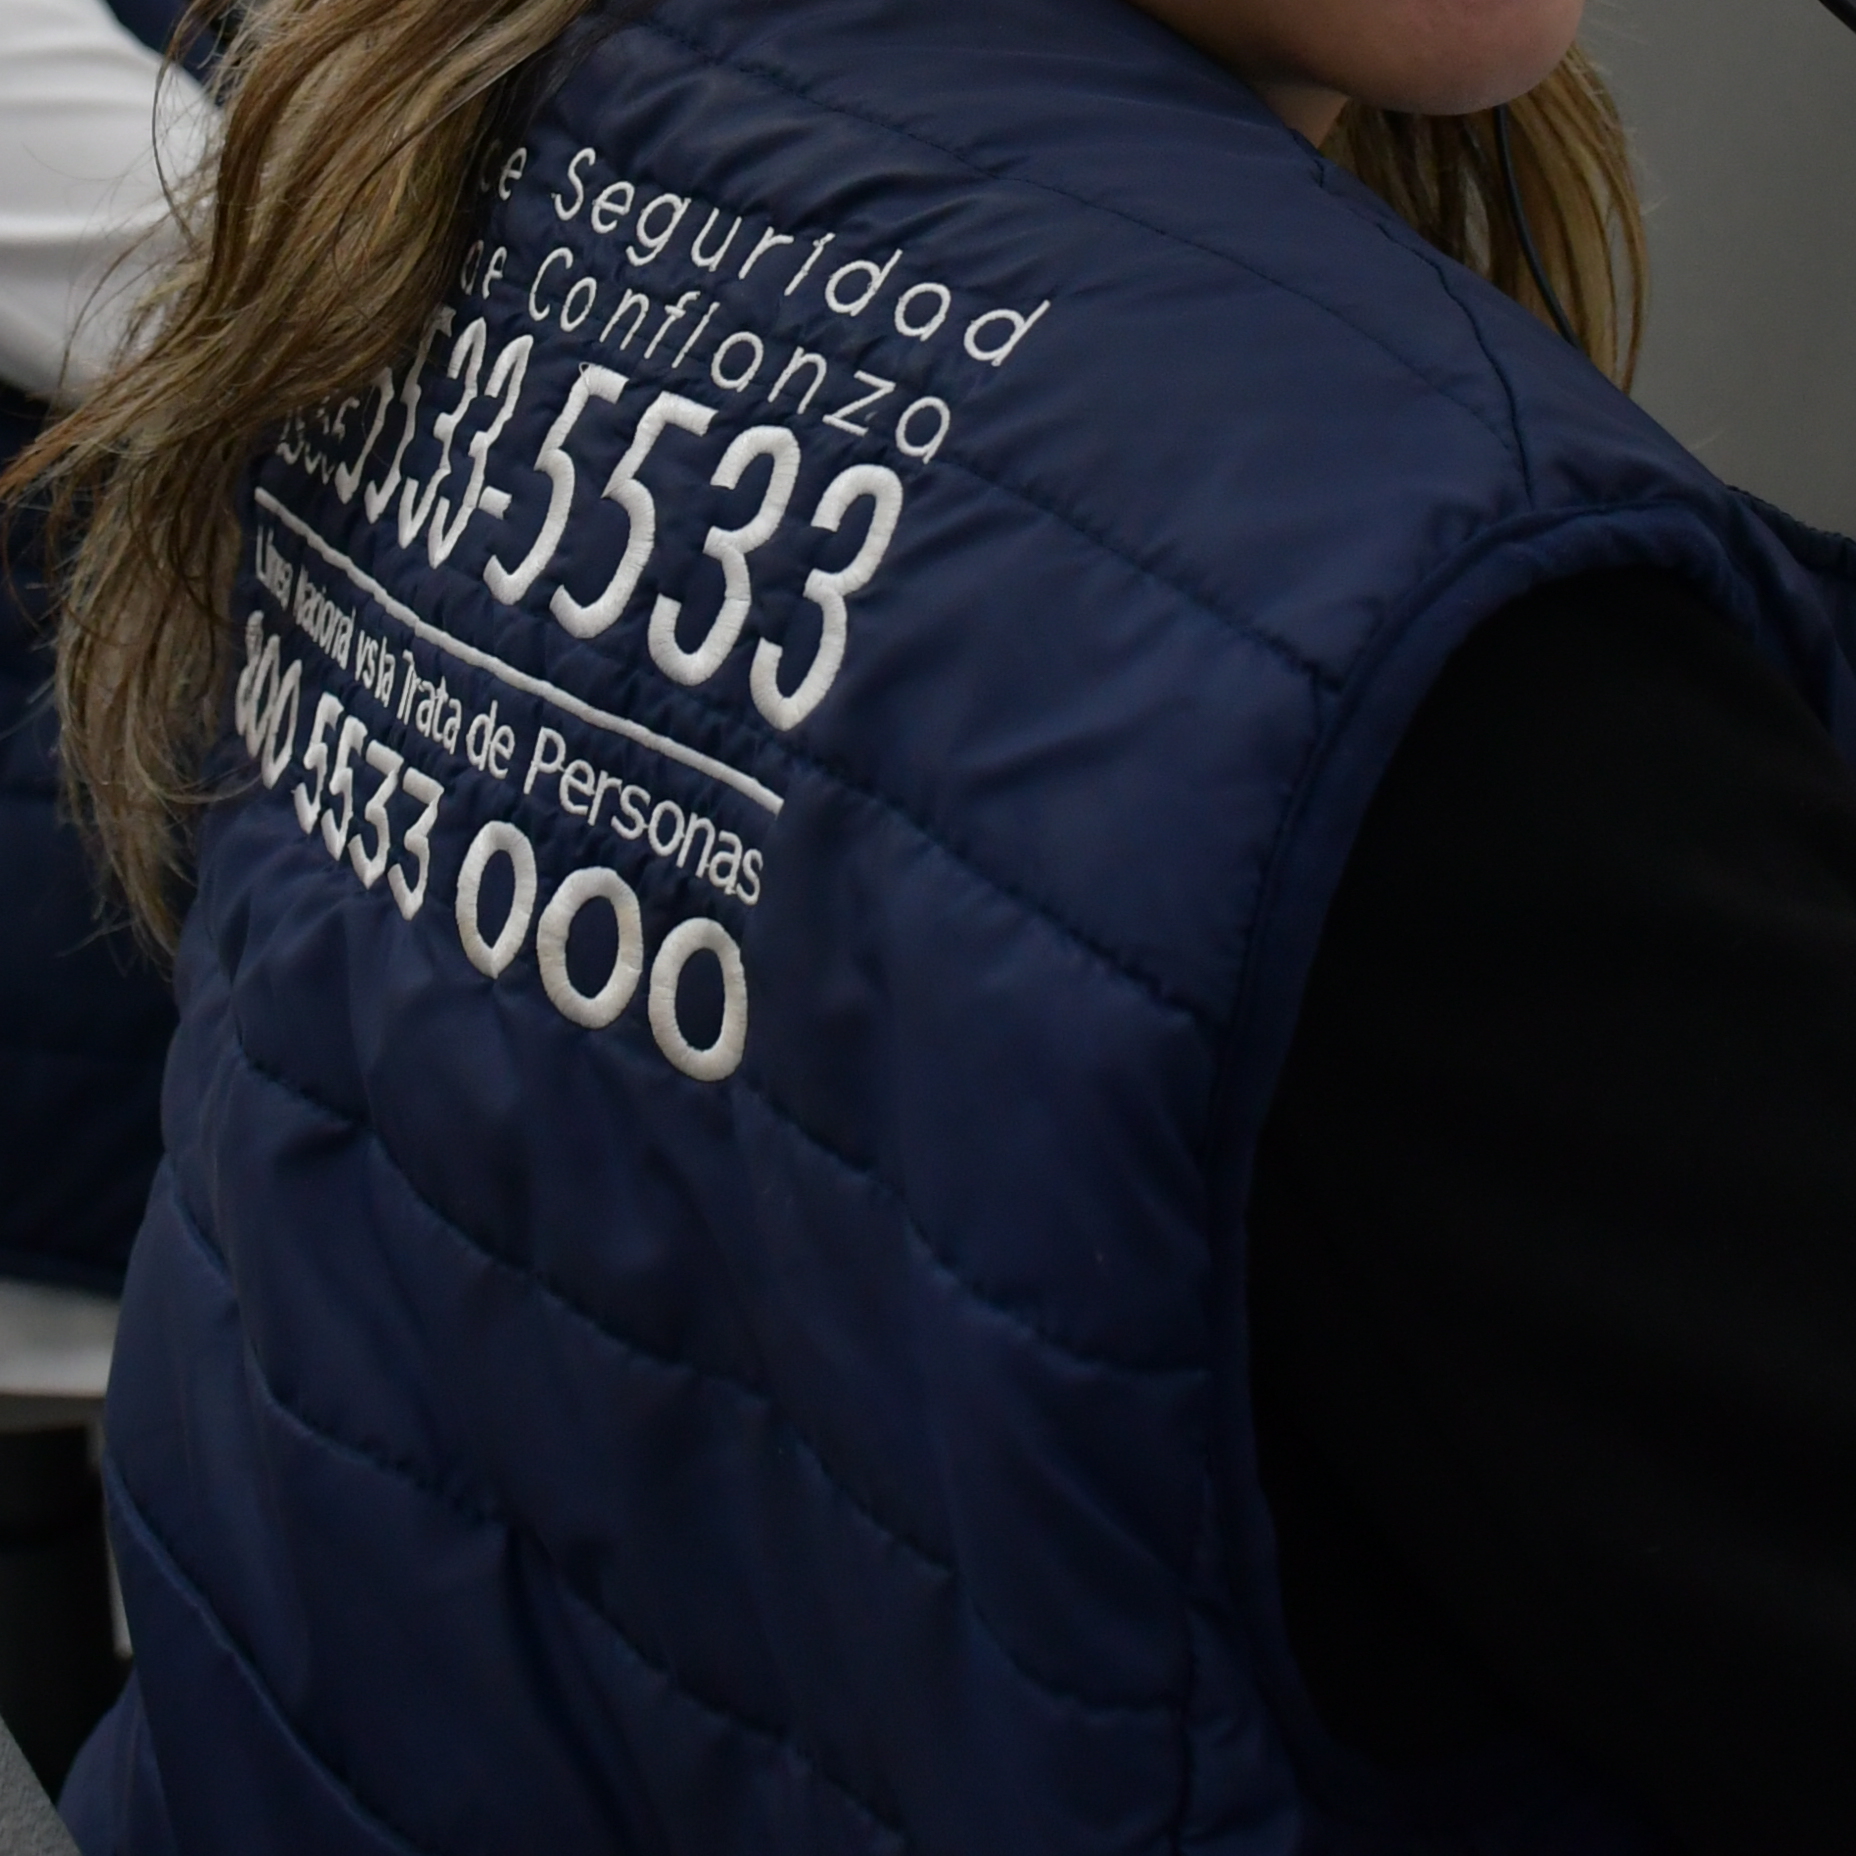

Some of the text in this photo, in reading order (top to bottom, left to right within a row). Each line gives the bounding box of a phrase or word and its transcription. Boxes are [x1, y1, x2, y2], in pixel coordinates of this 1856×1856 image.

[528, 246, 952, 465] Confianza
[551, 146, 1051, 367] Seguridad
[293, 564, 357, 670] Nacional
[396, 649, 462, 756] Trata
[466, 699, 516, 780] de
[523, 726, 764, 907] Personas
[292, 691, 445, 921] 5533
[455, 819, 749, 1083] 000
